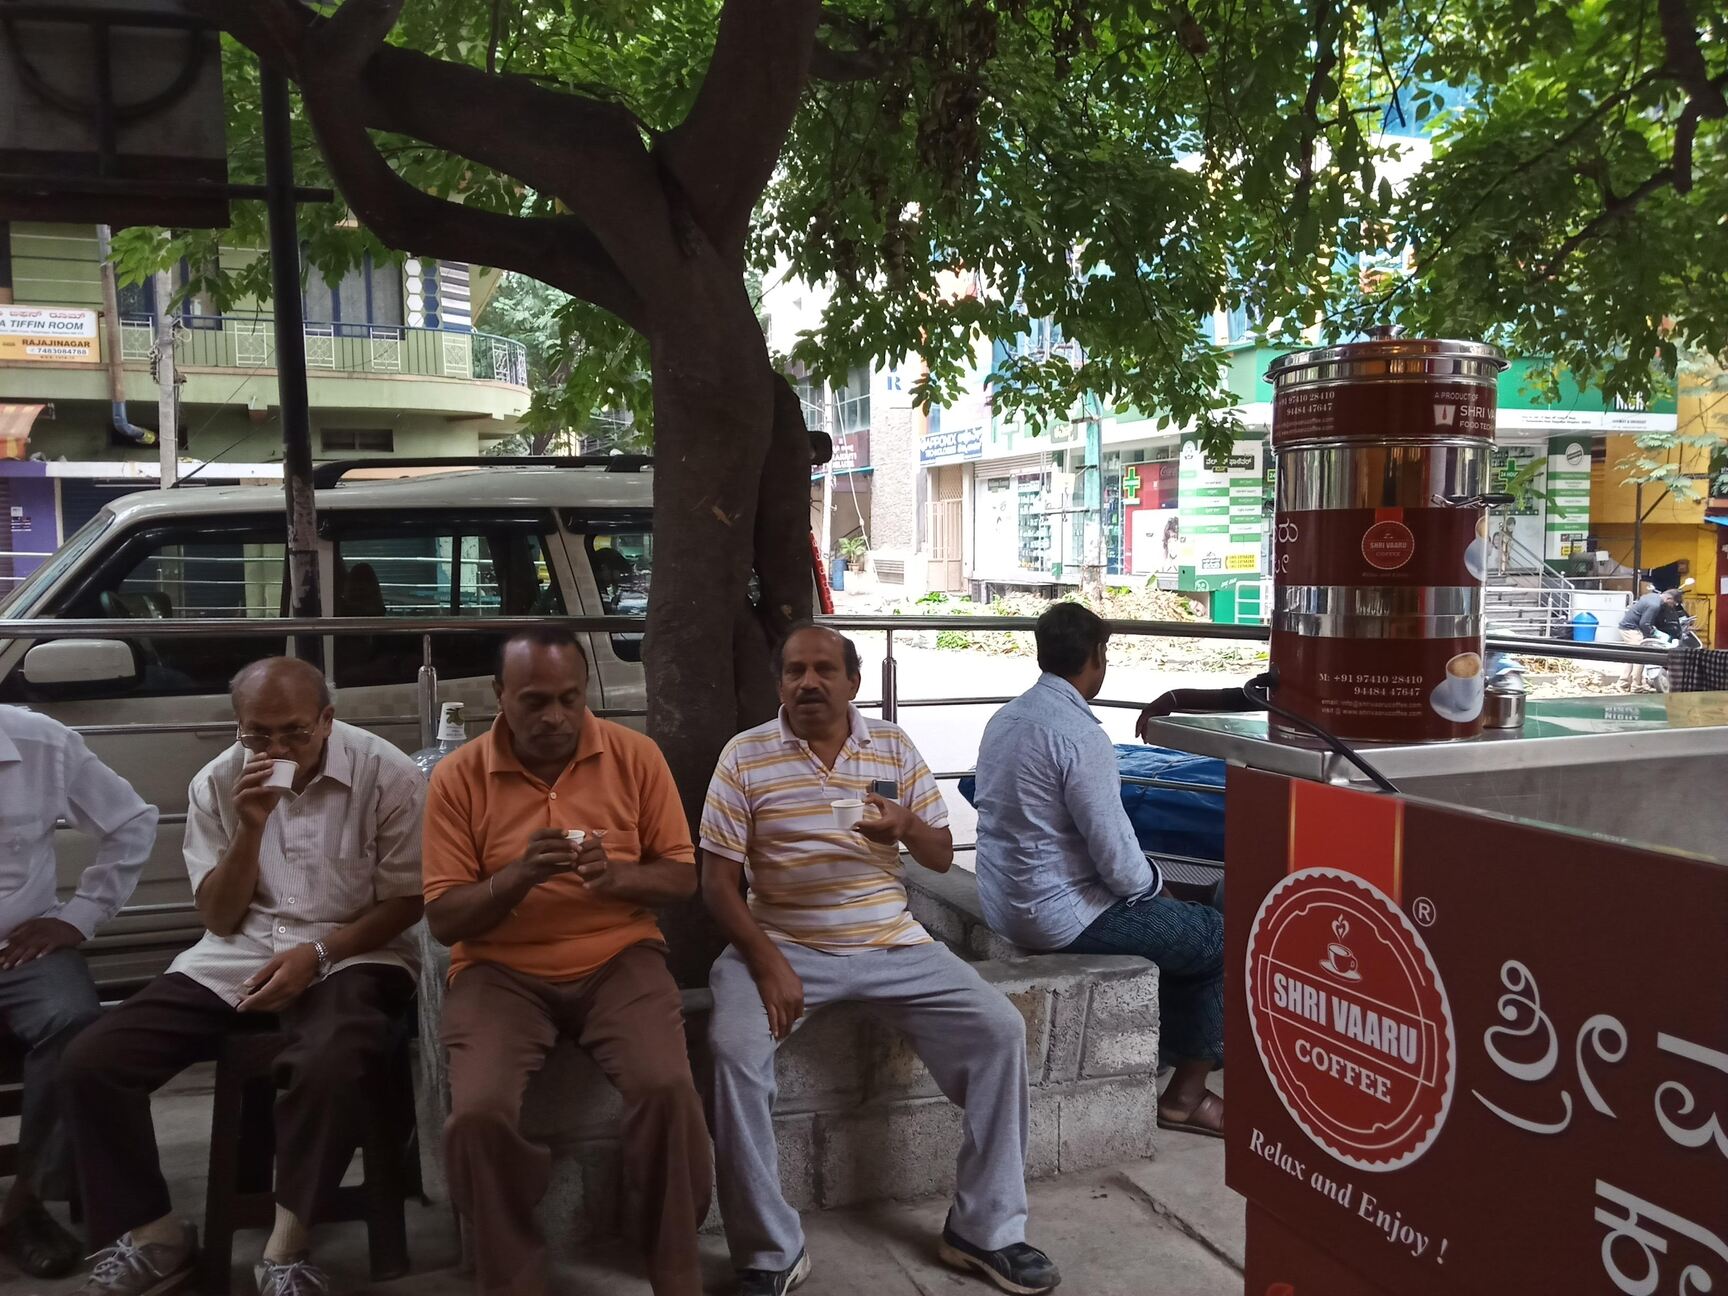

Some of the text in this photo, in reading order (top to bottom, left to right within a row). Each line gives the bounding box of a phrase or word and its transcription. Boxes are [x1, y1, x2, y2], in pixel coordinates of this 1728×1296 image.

[10, 320, 45, 329] TIFFIN
[48, 321, 84, 330] ROOM
[22, 339, 90, 348] RAJAJINAGAR
[1440, 392, 1471, 401] PRODUCT
[1460, 405, 1486, 418] SHRI
[1459, 420, 1480, 429] FOOD
[1334, 674, 1353, 683] +91
[1356, 674, 1389, 684] 97410
[1391, 675, 1423, 684] 28410
[1390, 687, 1421, 697] 47647
[1273, 972, 1417, 1064] SHRI VAARU
[1294, 1037, 1392, 1104] COFFEE
[1249, 1127, 1305, 1181] Relax
[1310, 1172, 1351, 1209] and
[1357, 1191, 1430, 1257] Enjoy
